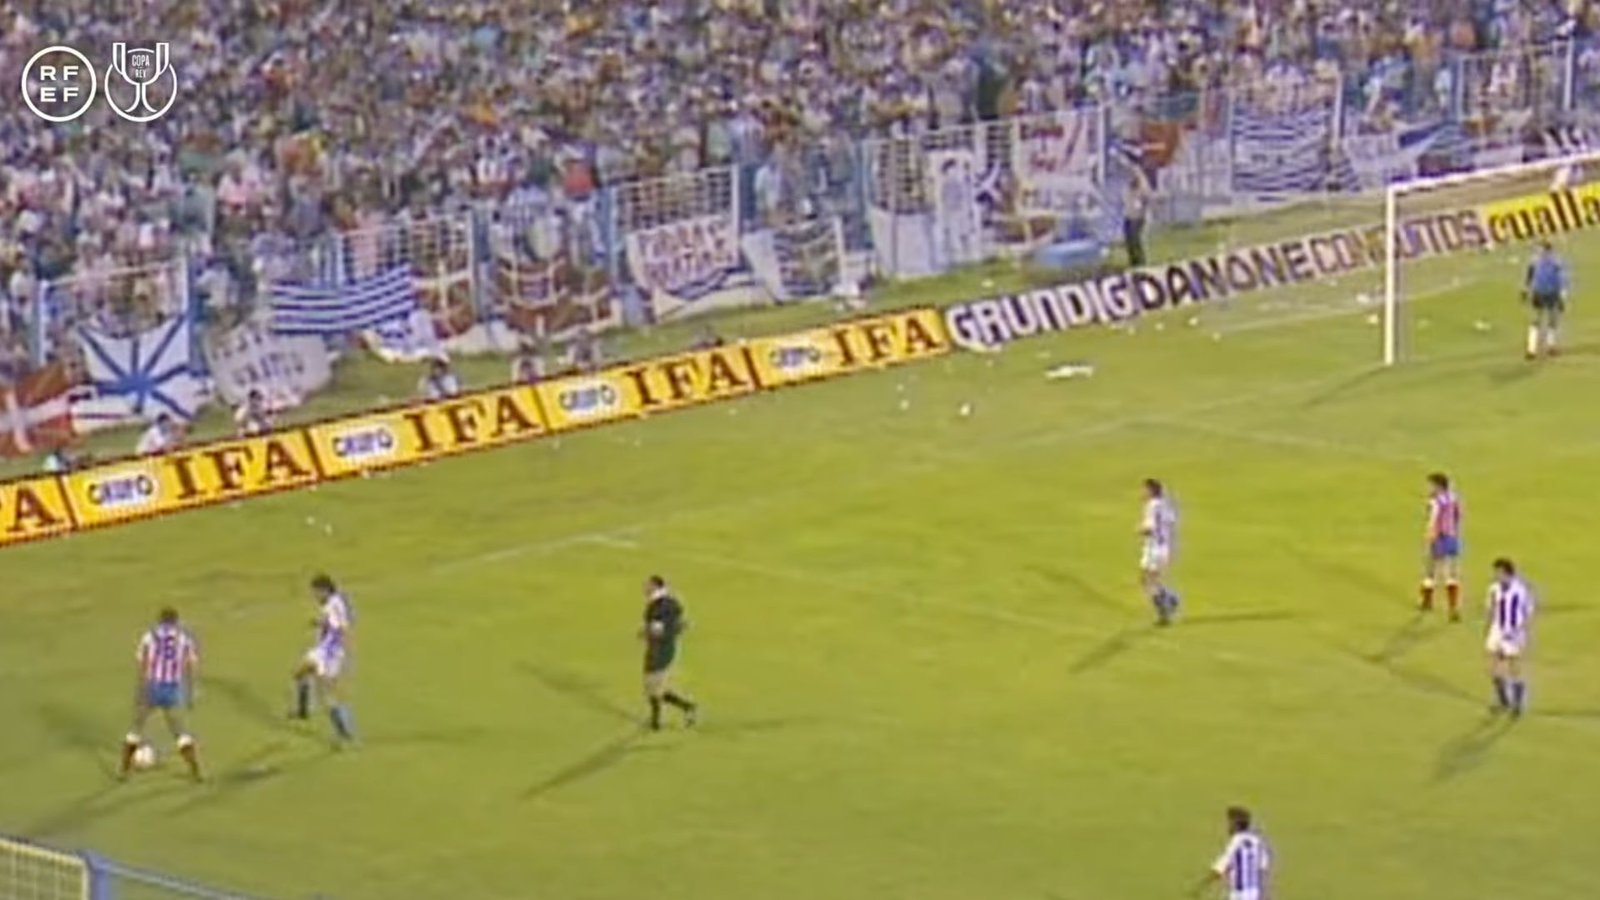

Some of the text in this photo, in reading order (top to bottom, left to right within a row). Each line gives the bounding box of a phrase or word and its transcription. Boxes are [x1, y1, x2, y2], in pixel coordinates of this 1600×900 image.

[1136, 242, 1312, 309] DANONE
[948, 276, 1135, 347] GRUNDIG
[833, 317, 941, 366] IFA
[628, 354, 744, 406] IFA
[403, 394, 538, 453] IFA
[171, 439, 309, 499] IFA
